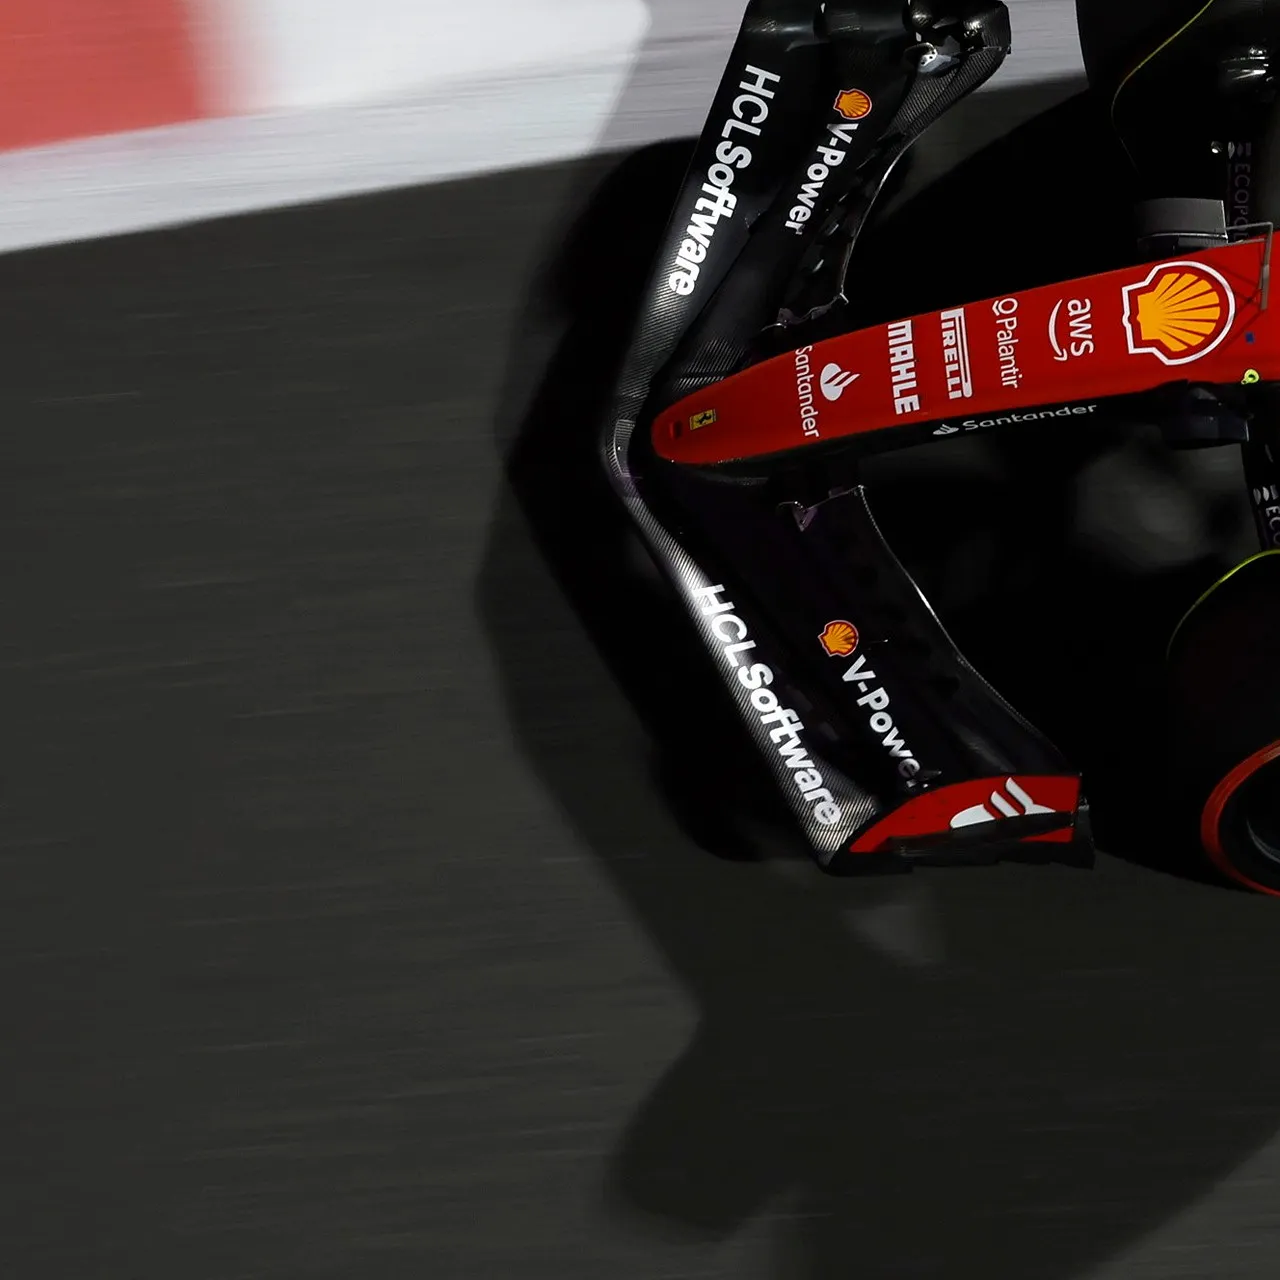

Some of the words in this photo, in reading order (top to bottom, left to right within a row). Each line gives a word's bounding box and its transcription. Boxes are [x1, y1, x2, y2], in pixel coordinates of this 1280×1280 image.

[669, 64, 780, 296] HCLSoftware
[785, 123, 859, 235] V-Power
[887, 319, 920, 415] MAHLE
[940, 307, 973, 400] PIRELLI
[996, 317, 1019, 389] Palantir
[1068, 297, 1094, 358] aws
[795, 344, 820, 438] Santander
[965, 404, 1097, 431] Santander
[692, 584, 842, 824] HCLSoftware
